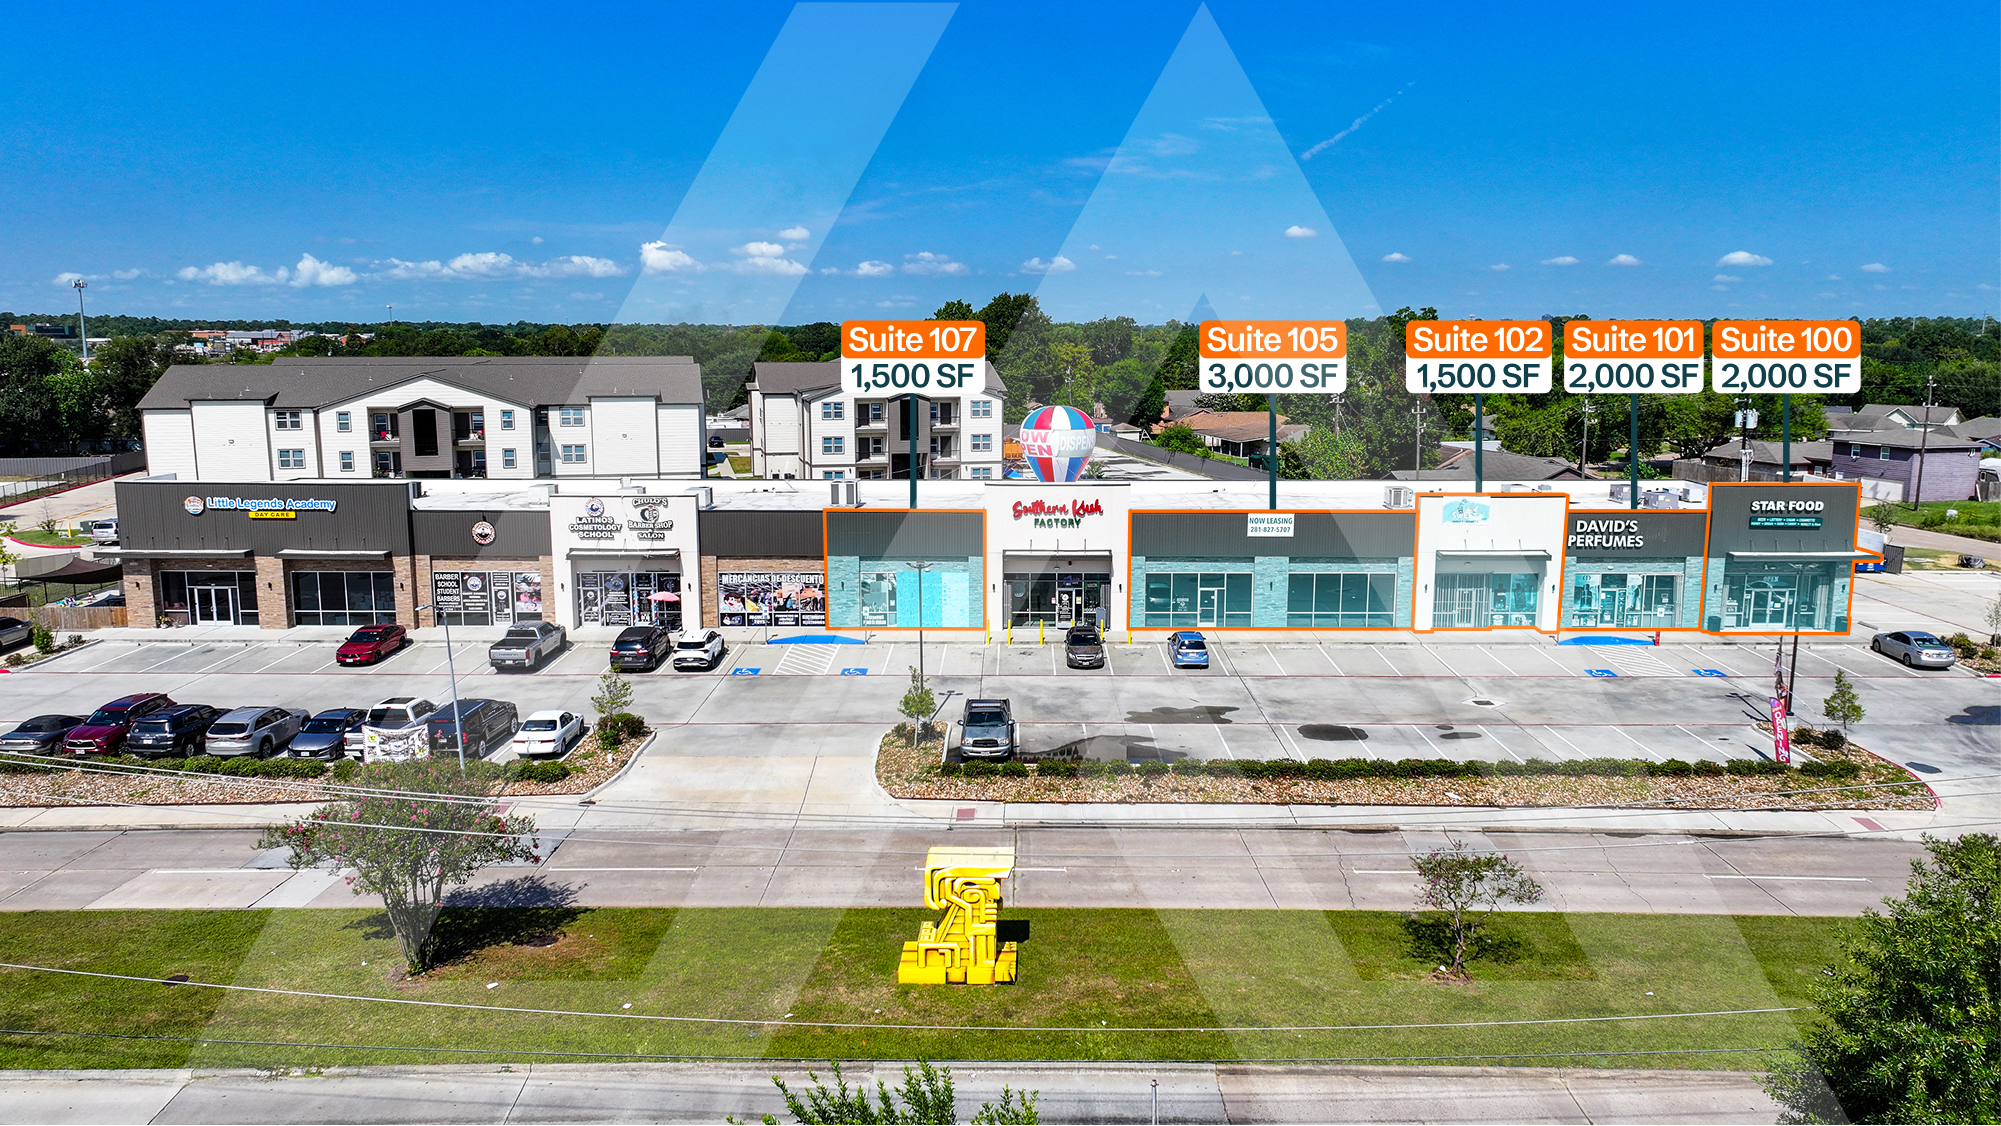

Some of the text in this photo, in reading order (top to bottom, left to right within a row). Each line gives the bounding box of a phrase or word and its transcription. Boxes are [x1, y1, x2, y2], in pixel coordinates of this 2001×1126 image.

[1021, 431, 1048, 443] OW
[1021, 444, 1053, 456] PEN
[206, 497, 235, 510] Little
[236, 497, 284, 511] Legends
[286, 498, 336, 511] Academy
[632, 498, 668, 508] CHULO'S
[1751, 501, 1825, 511] STAR FOOD
[1012, 500, 1068, 519] Southern
[576, 516, 613, 524] LATINOS
[628, 520, 673, 529] BARBER SHOP
[1034, 518, 1081, 528] FACTORY
[1249, 517, 1293, 525] NOW LEASING
[569, 523, 622, 531] COSMETOLOGY
[1576, 519, 1638, 533] DAVID'S
[1567, 535, 1644, 548] PERFUMES
[721, 574, 824, 585] MERCANCIAS DE DESCUENTO
[1774, 711, 1787, 762] OPENING
